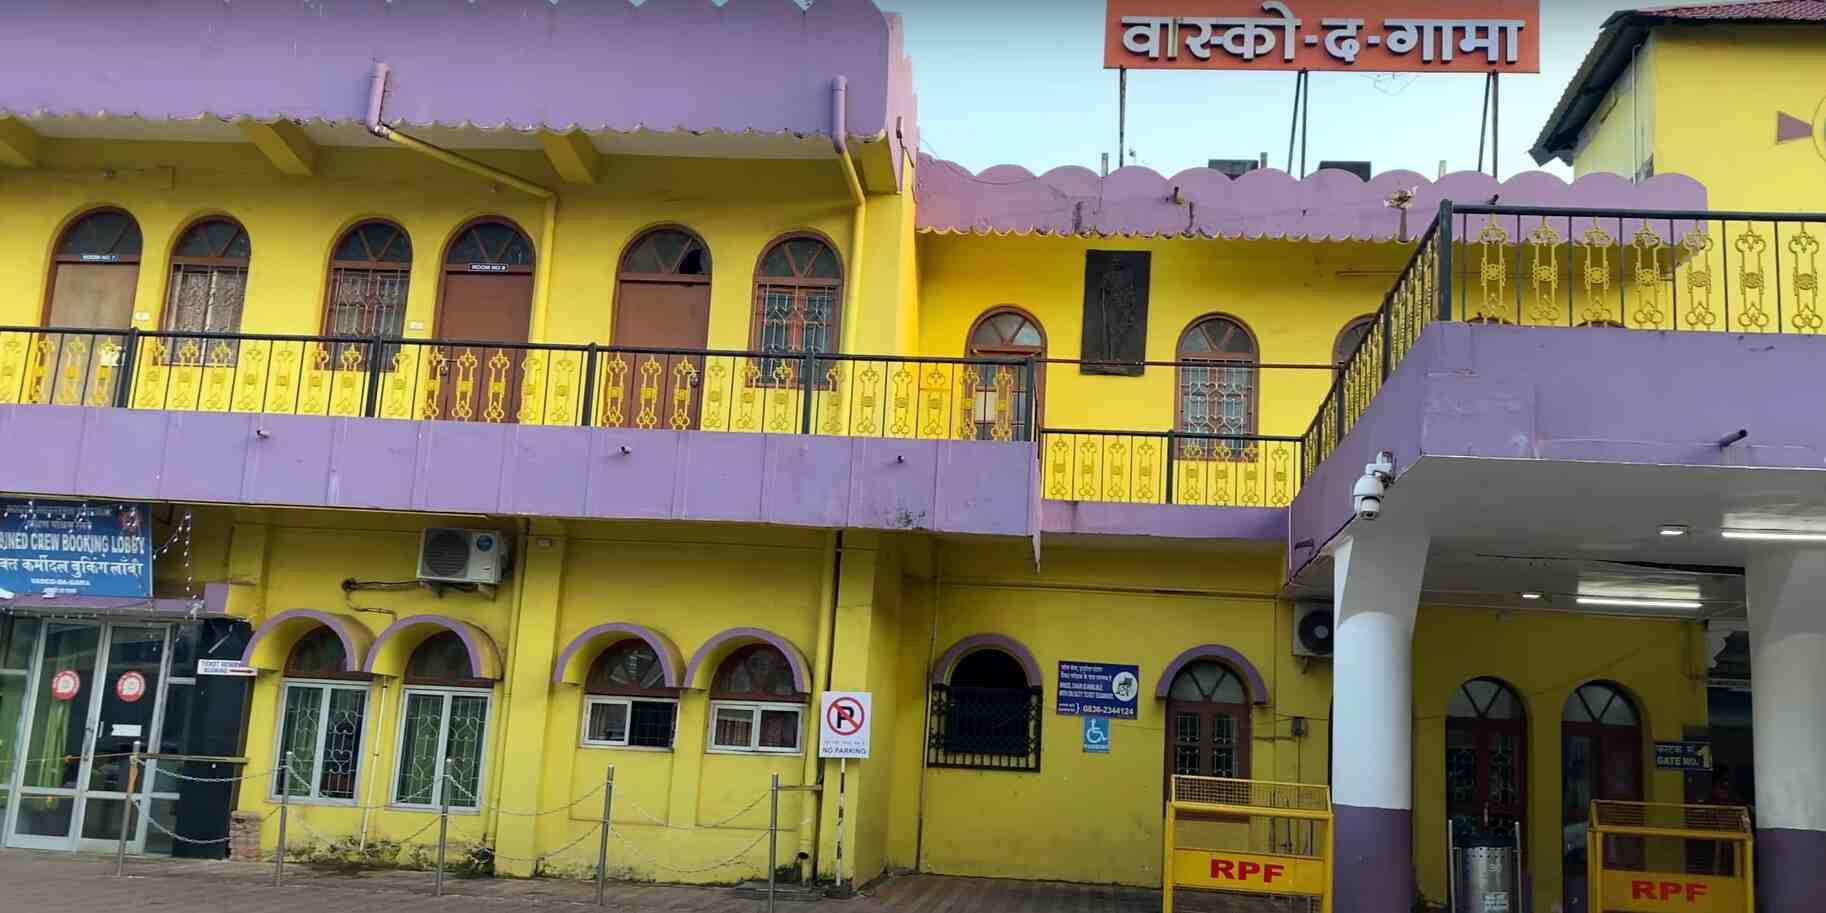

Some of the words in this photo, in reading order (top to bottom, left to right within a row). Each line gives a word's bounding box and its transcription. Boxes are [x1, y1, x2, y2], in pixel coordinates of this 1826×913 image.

[1121, 1, 1526, 63] वास्को-द-गामा
[30, 532, 60, 551] CREW
[62, 533, 109, 553] BOOKING
[111, 535, 145, 554] LOBBY
[835, 747, 867, 755] PARKING
[1657, 756, 1681, 766] GATE
[1210, 859, 1285, 883] RPF
[1631, 880, 1709, 902] RPF
